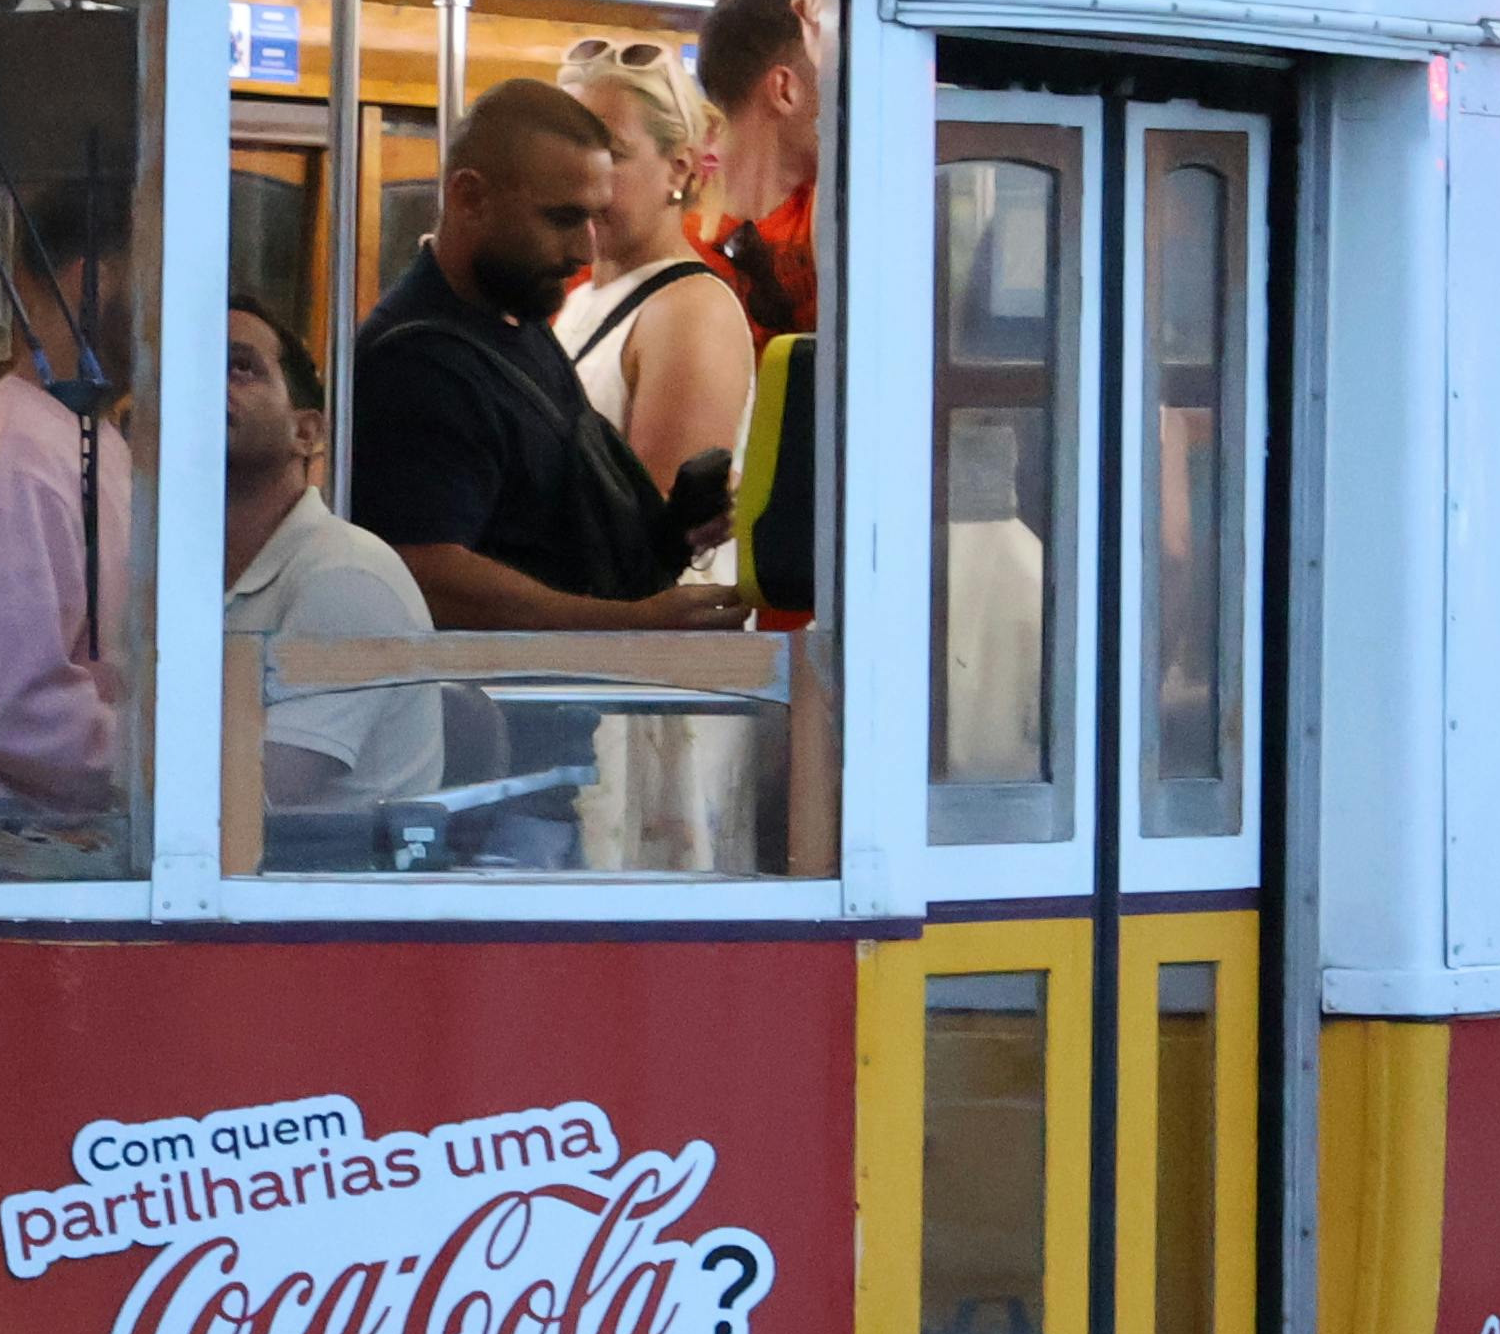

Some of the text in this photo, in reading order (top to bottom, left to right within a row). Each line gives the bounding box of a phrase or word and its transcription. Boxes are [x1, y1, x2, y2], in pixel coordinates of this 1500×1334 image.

[15, 1116, 602, 1261] partilharias uma
[88, 1108, 347, 1173] Com quem
